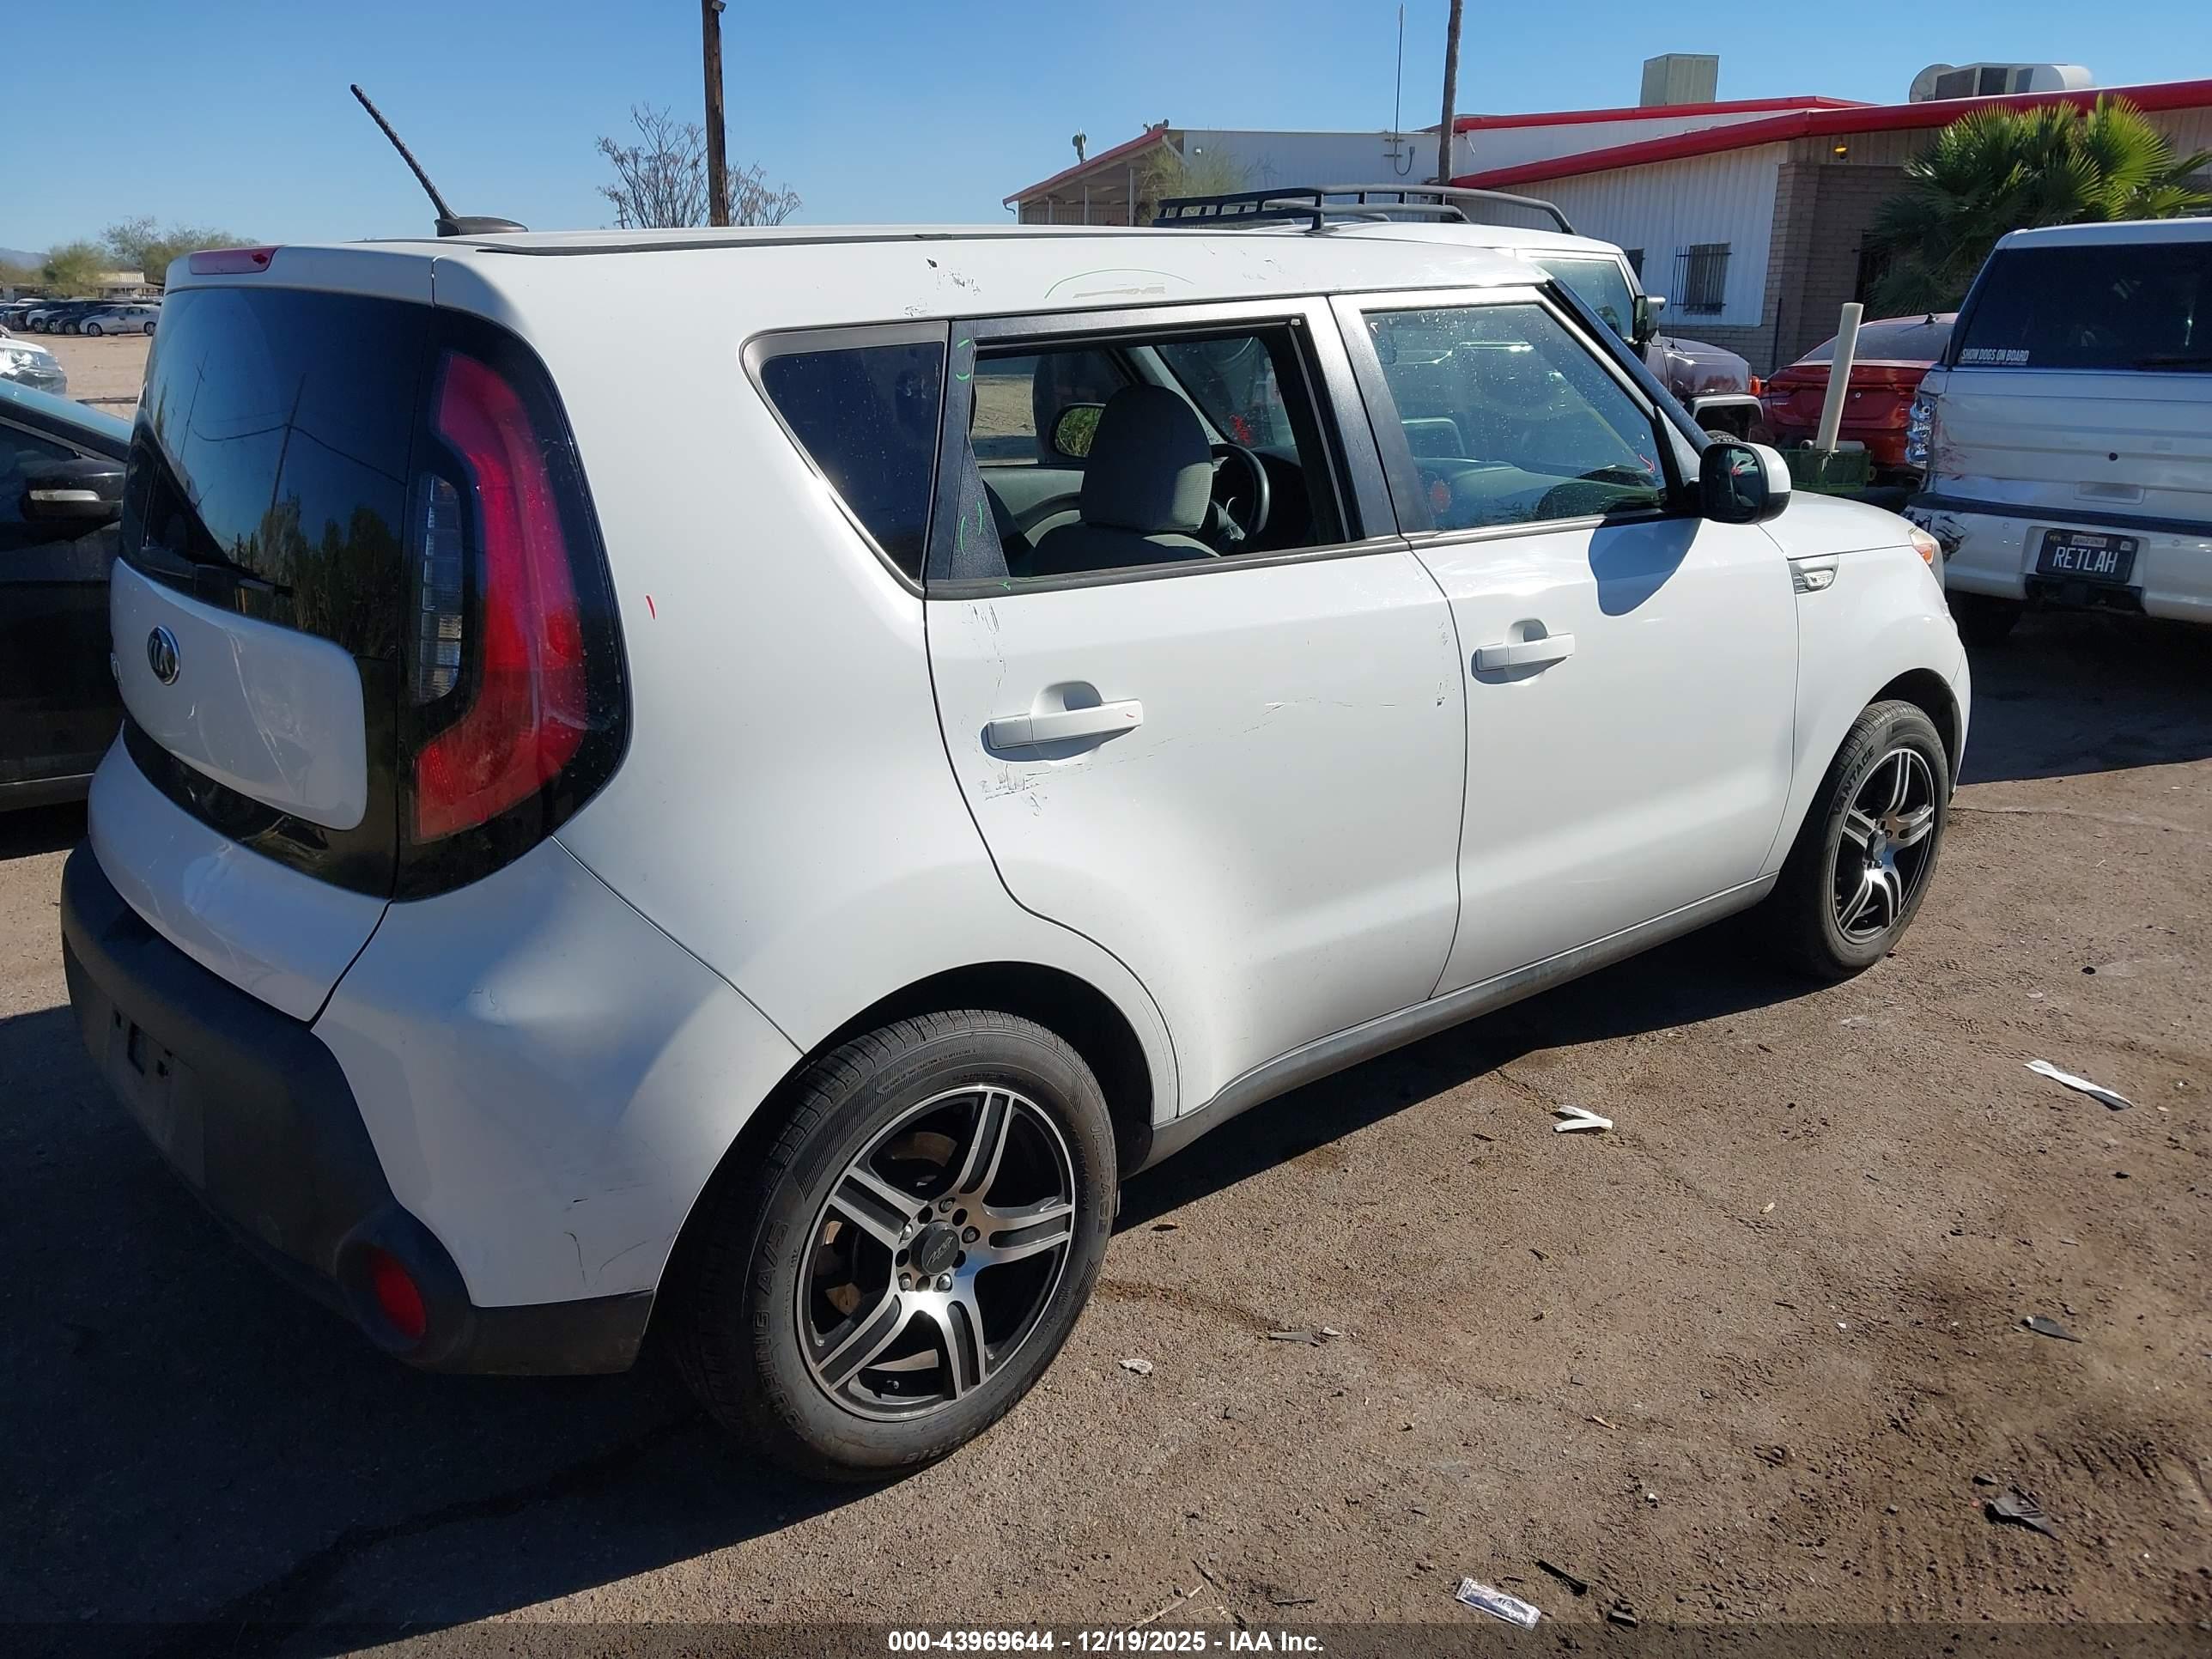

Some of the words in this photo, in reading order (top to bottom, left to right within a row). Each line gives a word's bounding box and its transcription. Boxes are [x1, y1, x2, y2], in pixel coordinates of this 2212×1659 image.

[1961, 349, 1979, 360] SHOW
[1978, 349, 1996, 361] DOGS
[1996, 349, 2007, 361] ON
[2006, 349, 2029, 362] BOARD
[2052, 546, 2118, 574] RETLAH
[1833, 745, 1875, 815] VANTAGE
